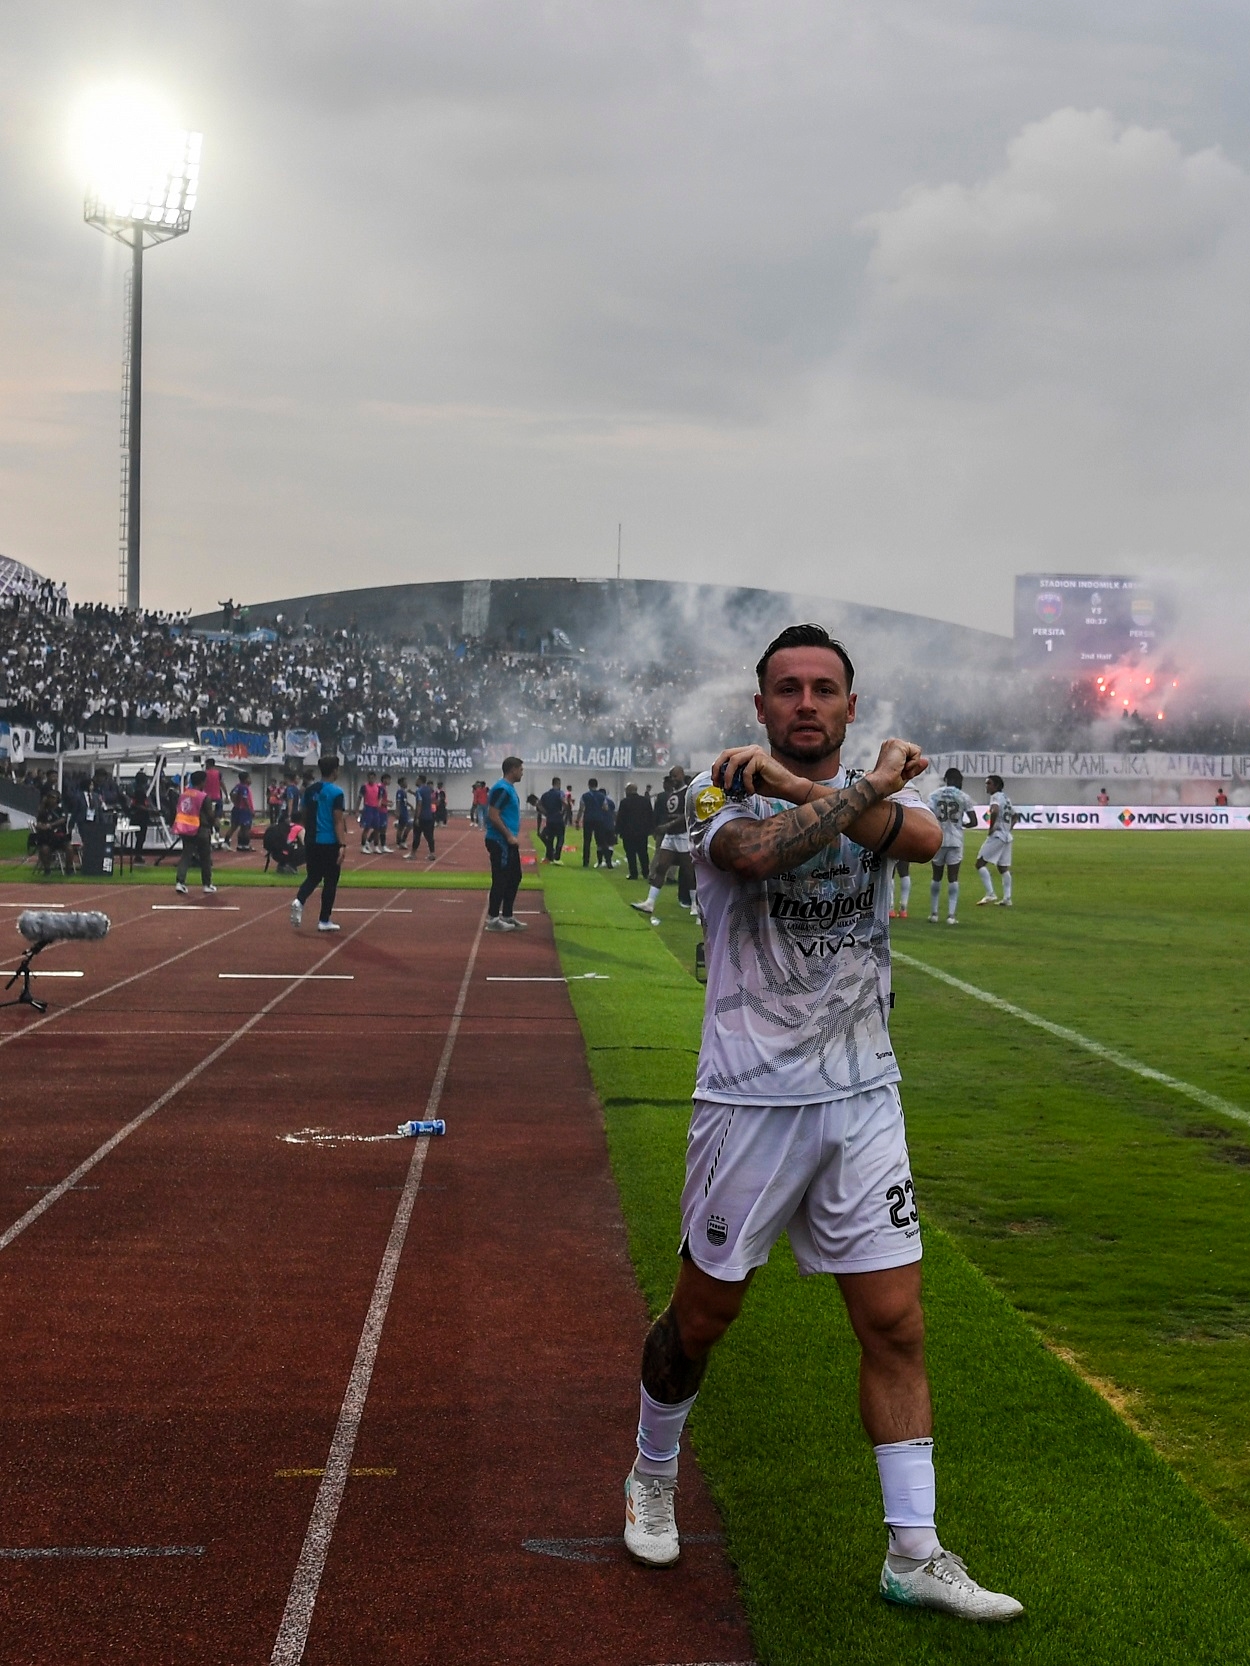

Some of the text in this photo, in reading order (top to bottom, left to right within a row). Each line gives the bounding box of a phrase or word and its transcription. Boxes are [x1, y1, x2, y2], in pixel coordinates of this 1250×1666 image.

[1040, 580, 1076, 588] STADION
[1078, 581, 1120, 589] INDOMILK
[1091, 607, 1102, 615] VS
[1032, 628, 1065, 636] PERSITA
[1045, 639, 1053, 653] 1
[1140, 642, 1148, 654] 2
[381, 756, 409, 768] KAMI
[412, 757, 445, 768] PERSIB
[447, 757, 473, 768] FANS
[579, 746, 610, 767] LAGI
[945, 754, 1005, 774] TUNTUT
[1012, 755, 1064, 775] GAIRAH
[936, 800, 960, 823] 32
[1018, 812, 1043, 823] NC
[1138, 813, 1177, 824] MNC
[886, 1179, 918, 1228] 23
